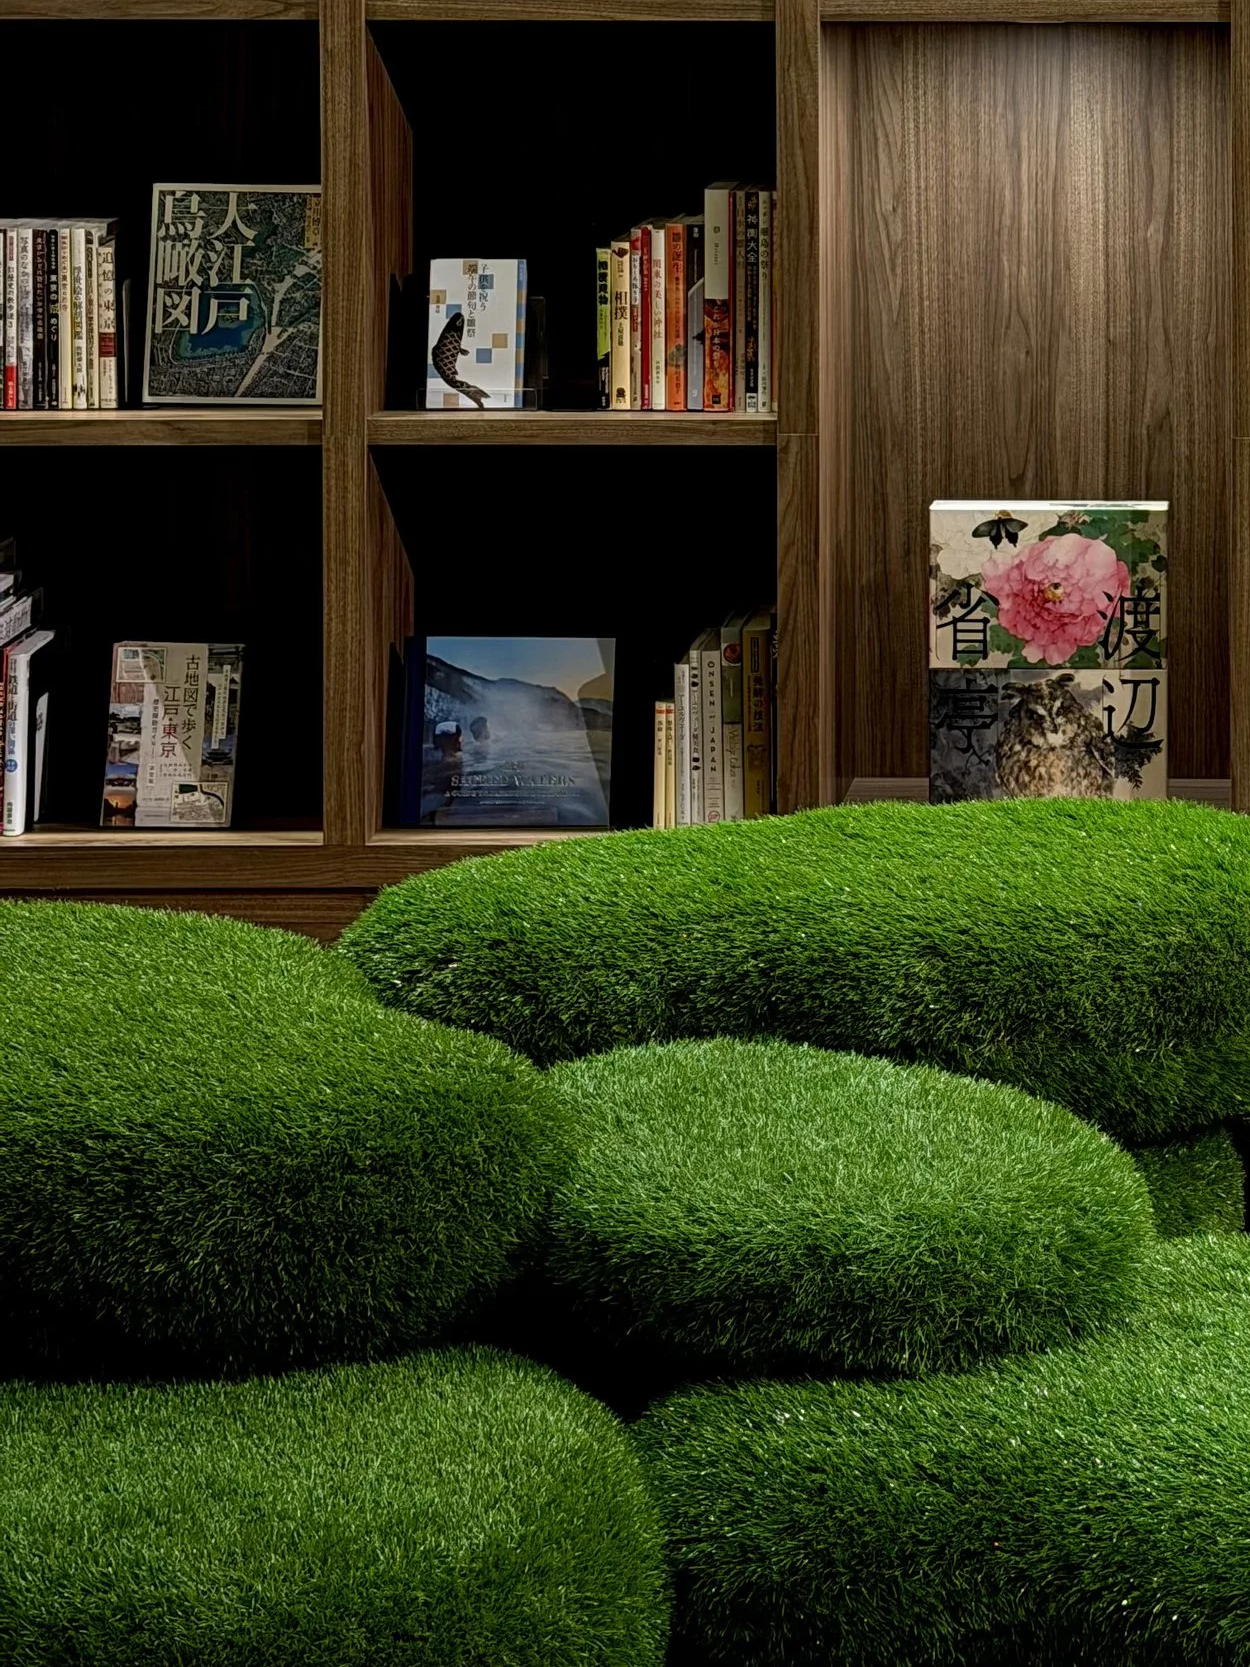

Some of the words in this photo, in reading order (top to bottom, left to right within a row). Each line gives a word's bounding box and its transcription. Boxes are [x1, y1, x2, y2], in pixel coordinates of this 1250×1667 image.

[102, 251, 116, 330] 追憶の東京
[201, 191, 259, 335] 大江戸
[614, 290, 628, 320] 相撲
[182, 654, 201, 750] 古地図で歩く
[707, 660, 716, 707] ONSEN
[935, 584, 999, 752] 省亭
[1096, 585, 1165, 751] 渡辺
[160, 686, 181, 759] 江戸・東京
[709, 726, 717, 773] JAPAN
